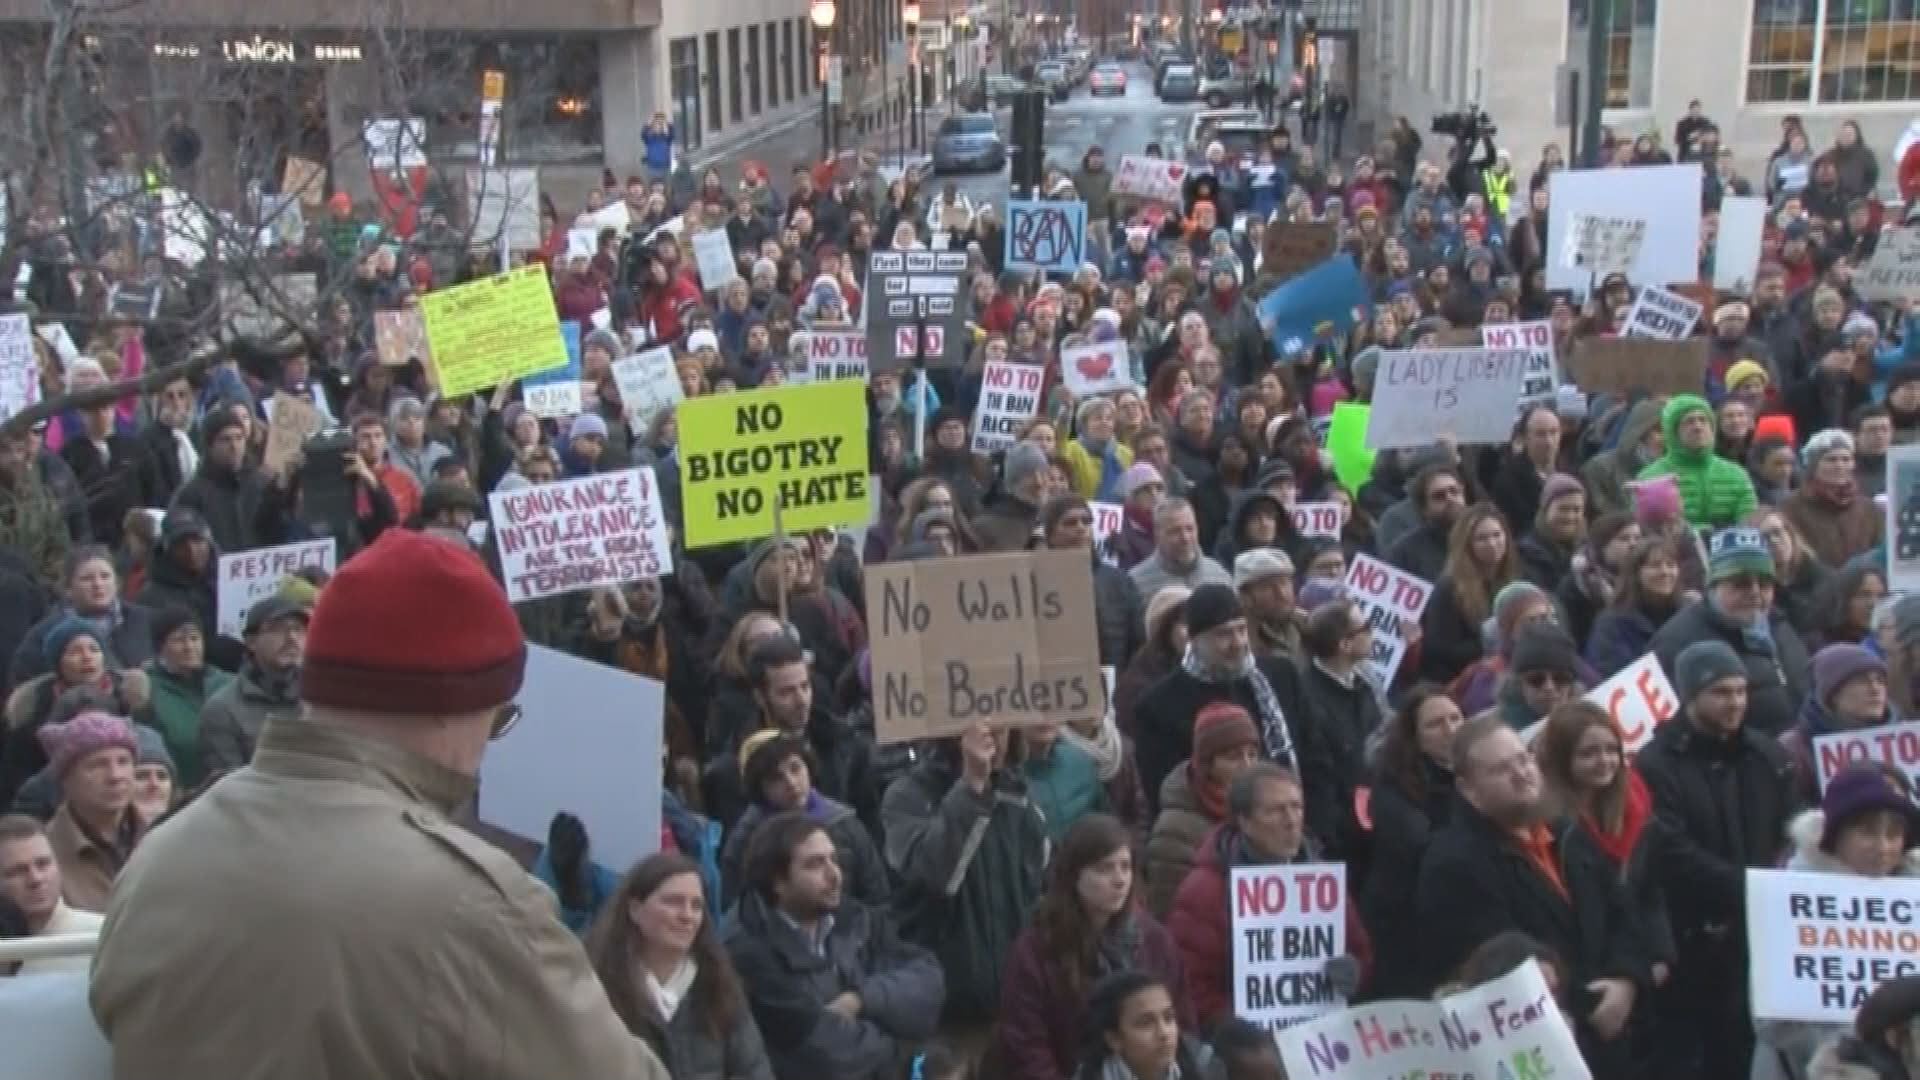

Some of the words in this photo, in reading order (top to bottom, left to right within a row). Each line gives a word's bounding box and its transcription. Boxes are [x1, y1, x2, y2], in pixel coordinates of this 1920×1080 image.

[811, 336, 840, 357] NO
[1487, 331, 1516, 348] NO
[1522, 325, 1548, 345] TO
[985, 366, 1012, 388] NO
[1018, 369, 1040, 391] TO
[1388, 353, 1449, 385] LADY
[1005, 393, 1034, 413] BAN
[1433, 385, 1458, 410] IS
[736, 402, 783, 436] NO
[687, 434, 843, 483] BIGOTRY
[502, 478, 633, 523] IGNORANCE
[715, 487, 764, 520] NO
[778, 470, 866, 510] HATE
[500, 505, 657, 555] INTOLERANCE
[1312, 508, 1337, 531] TO
[230, 545, 330, 582] RESPECT
[1350, 558, 1389, 596] NO
[1390, 576, 1425, 612] TO
[882, 576, 931, 638] No
[957, 570, 1063, 623] Walls
[884, 670, 928, 721] No
[945, 652, 1090, 719] Borders
[1820, 740, 1869, 779] NO
[1875, 732, 1920, 768] TO
[1237, 875, 1287, 918] NO
[1293, 873, 1339, 914] TO
[1789, 893, 1920, 923] REJEC
[1244, 927, 1275, 964] THE
[1283, 924, 1335, 961] BAN
[1797, 925, 1920, 953] BANNO
[1794, 954, 1918, 984] REJEC
[1245, 972, 1335, 1010] RACISM
[1821, 983, 1871, 1010] HA
[1305, 1031, 1350, 1076] No
[1439, 1009, 1483, 1052] No
[1488, 994, 1547, 1040] Fear
